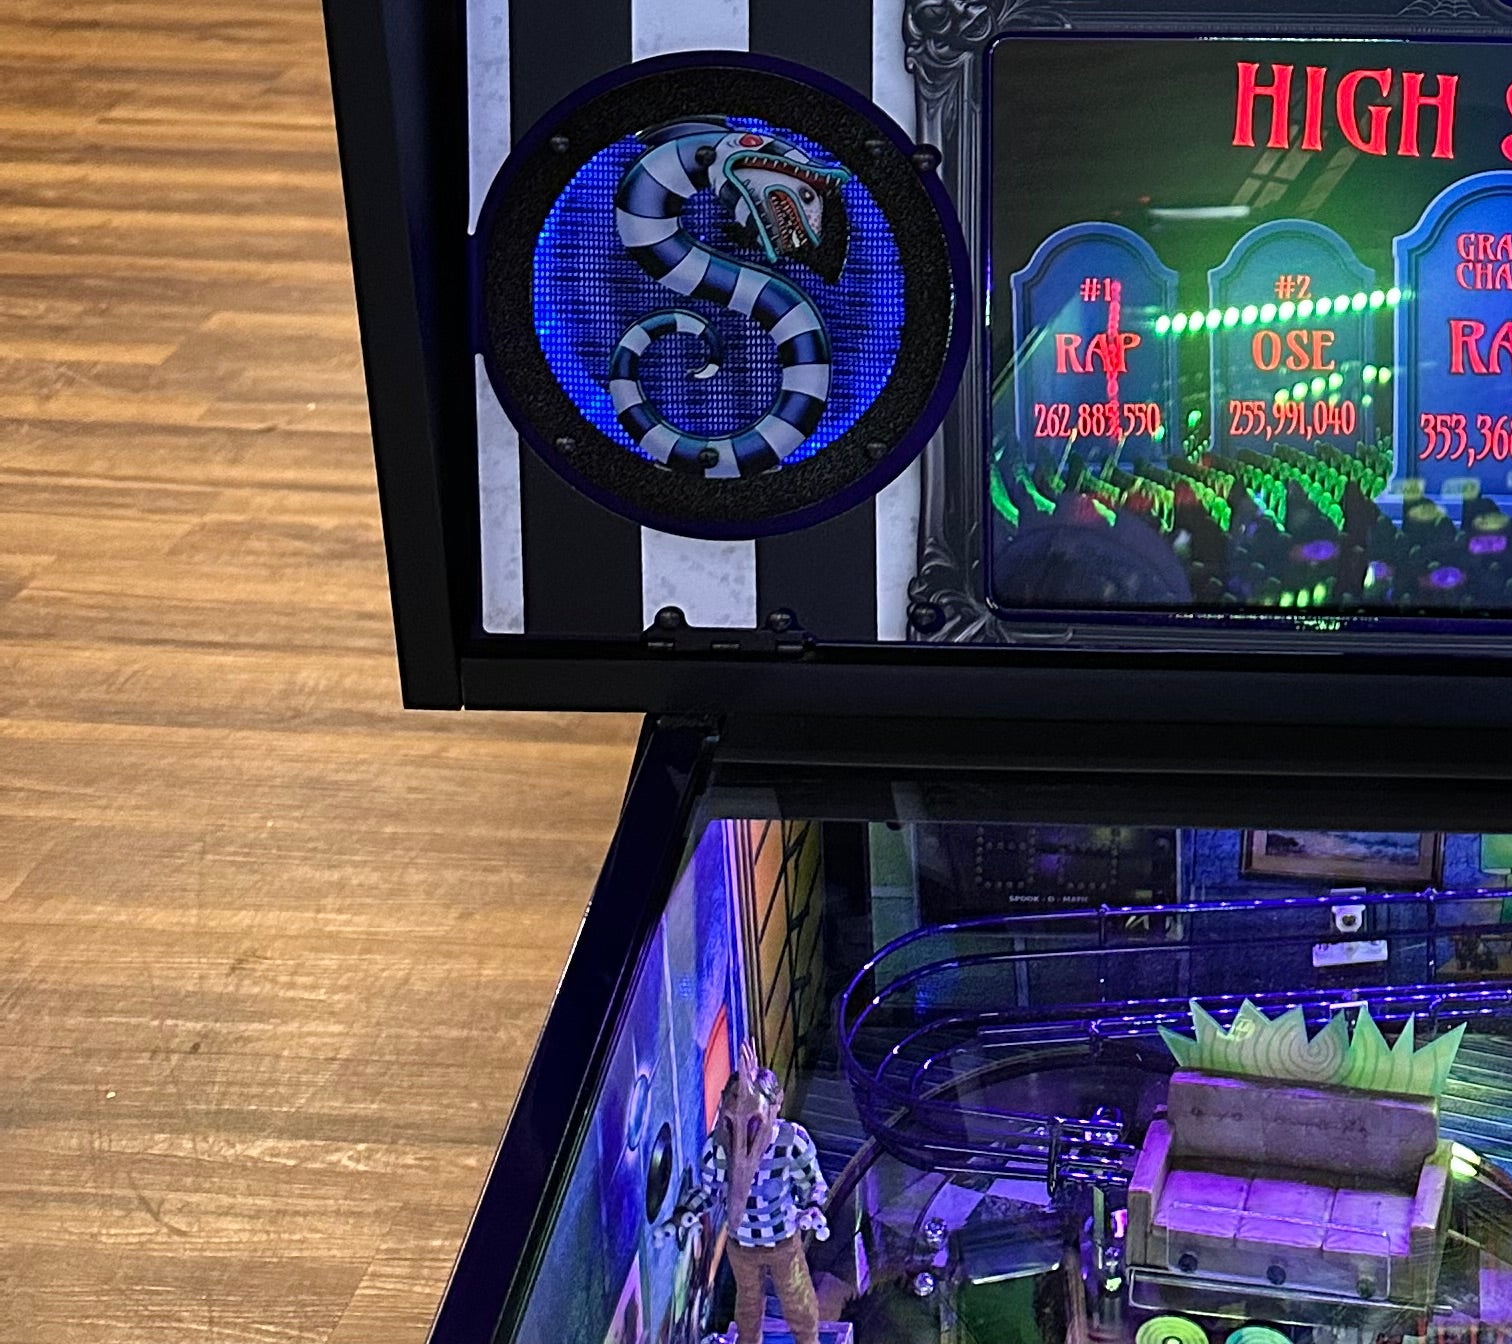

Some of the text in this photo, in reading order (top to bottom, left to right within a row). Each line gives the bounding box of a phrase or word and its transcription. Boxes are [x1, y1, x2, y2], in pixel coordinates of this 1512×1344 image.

[1231, 61, 1460, 160] HIGH
[1080, 278, 1112, 302] #1
[1274, 275, 1312, 299] #2
[1055, 333, 1142, 373] RAP
[1252, 329, 1335, 371] OSE
[1229, 400, 1356, 441] 255,991,040
